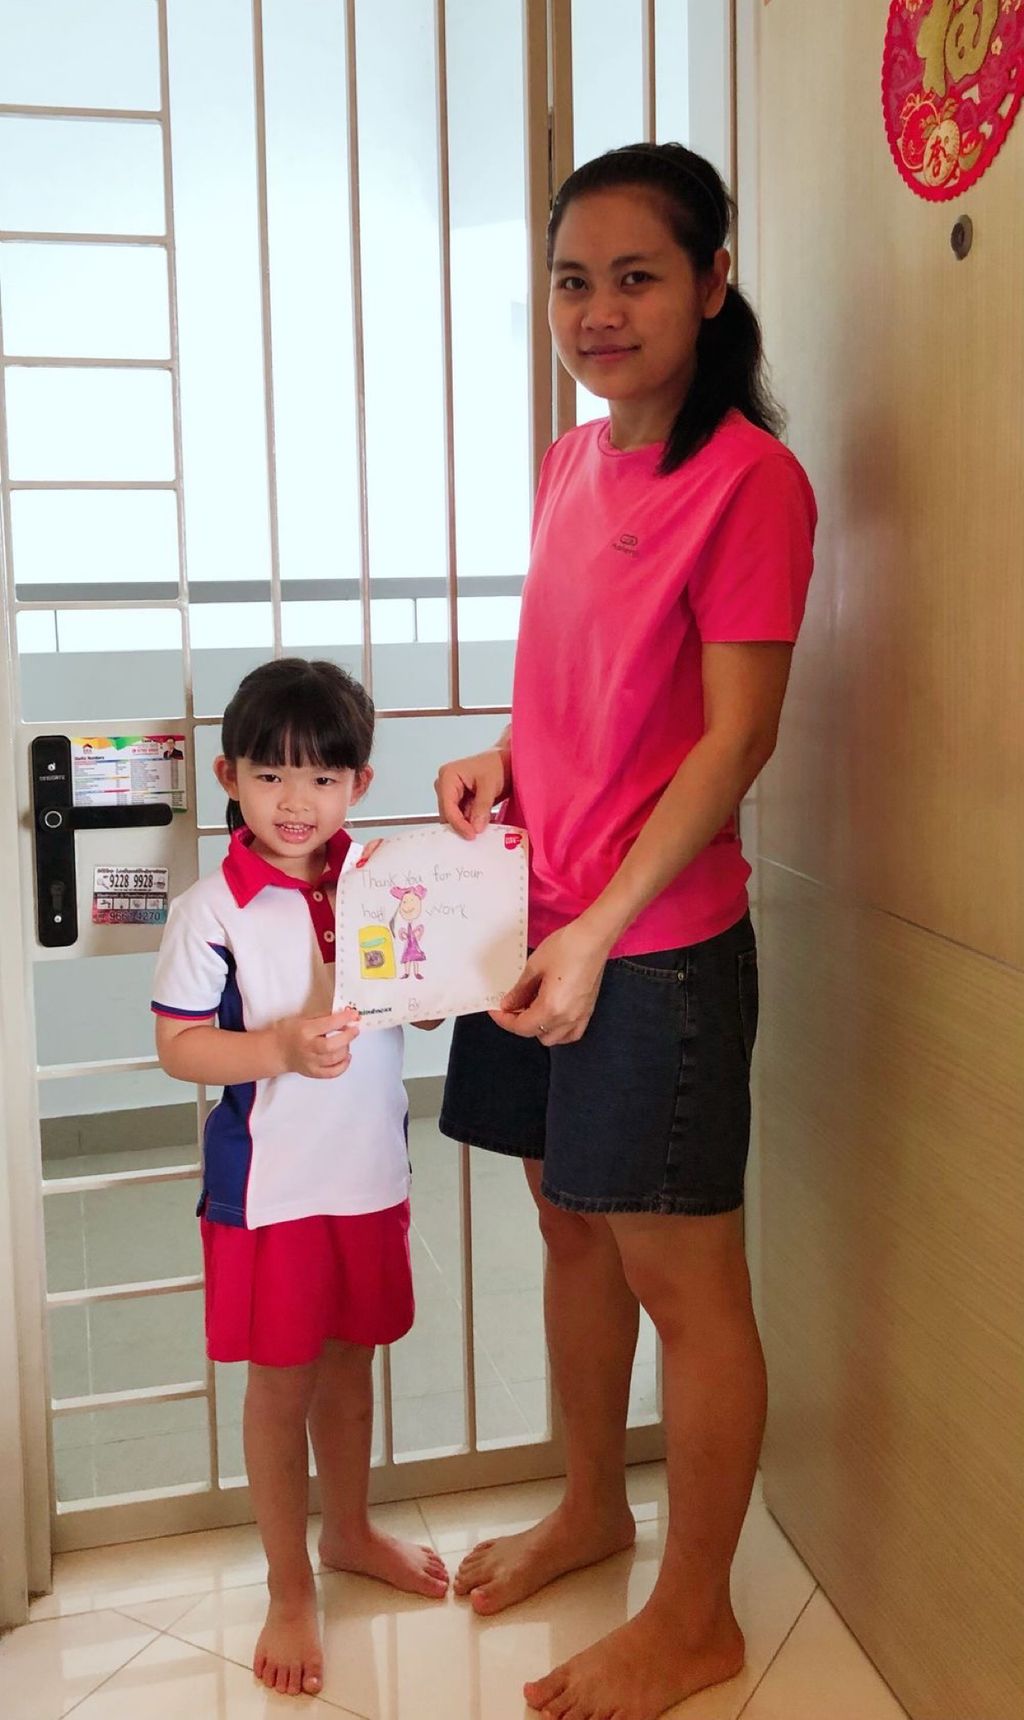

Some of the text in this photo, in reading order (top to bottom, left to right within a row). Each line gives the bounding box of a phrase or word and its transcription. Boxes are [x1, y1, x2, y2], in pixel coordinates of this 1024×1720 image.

[109, 874, 154, 888] 9228 9928
[361, 868, 398, 888] Thank
[433, 864, 451, 881] for
[425, 903, 468, 919] work
